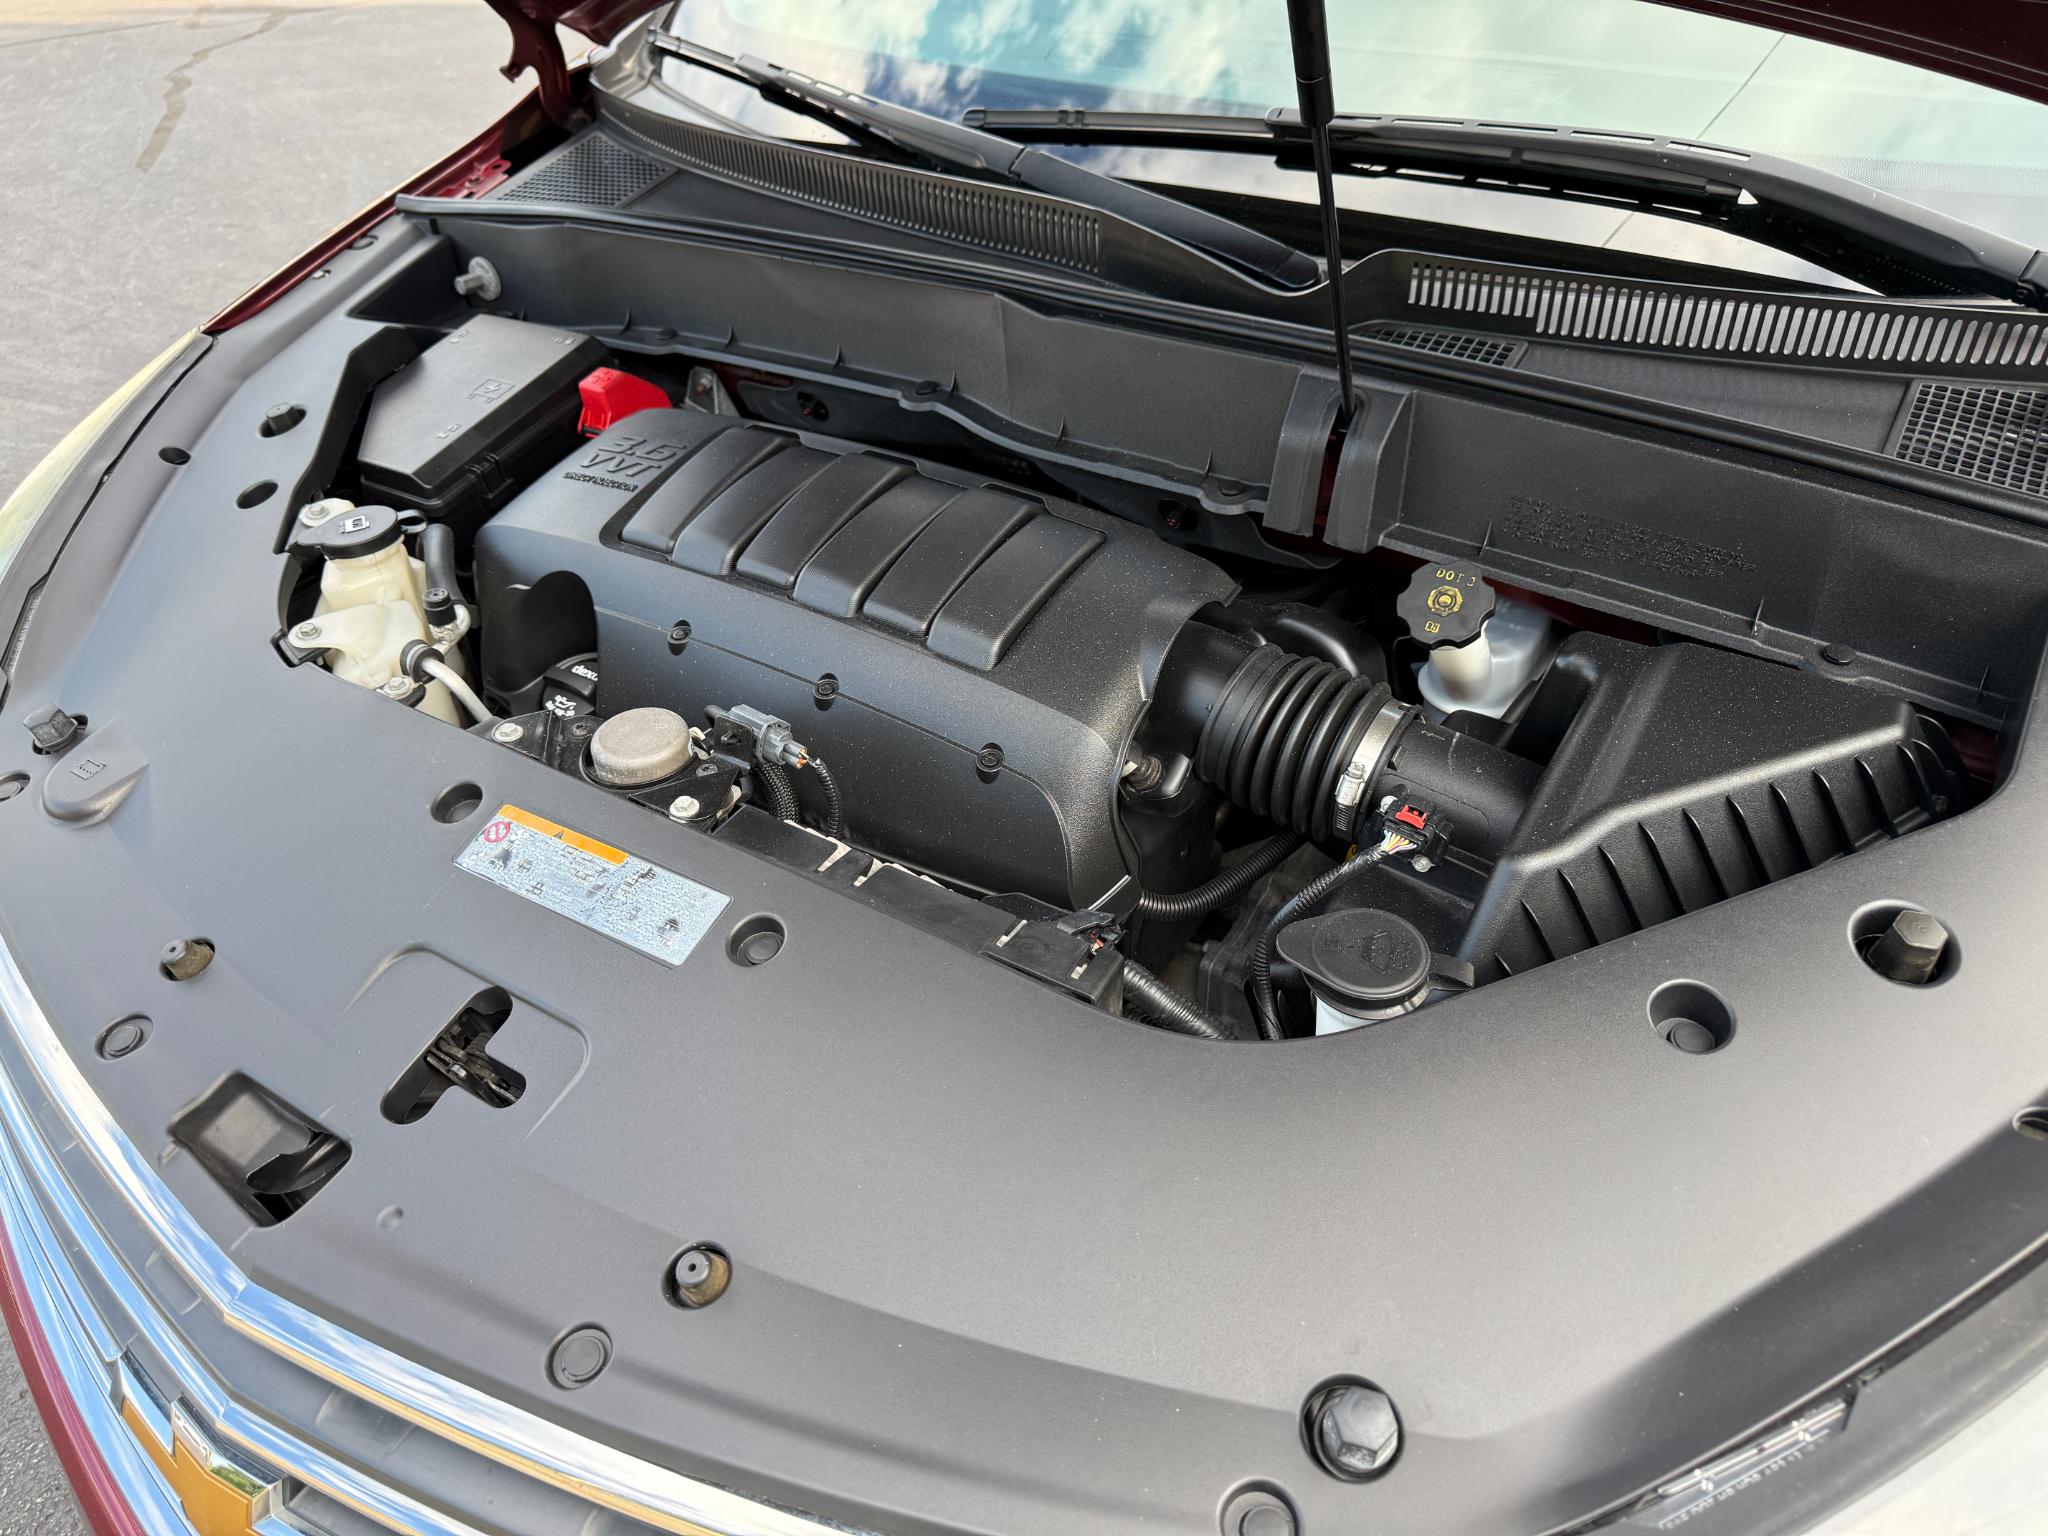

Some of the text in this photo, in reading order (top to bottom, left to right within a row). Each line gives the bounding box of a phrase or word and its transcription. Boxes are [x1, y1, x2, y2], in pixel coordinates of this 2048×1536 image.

[598, 436, 687, 461] 3.6
[580, 453, 661, 477] VVT
[1466, 576, 1477, 587] 3
